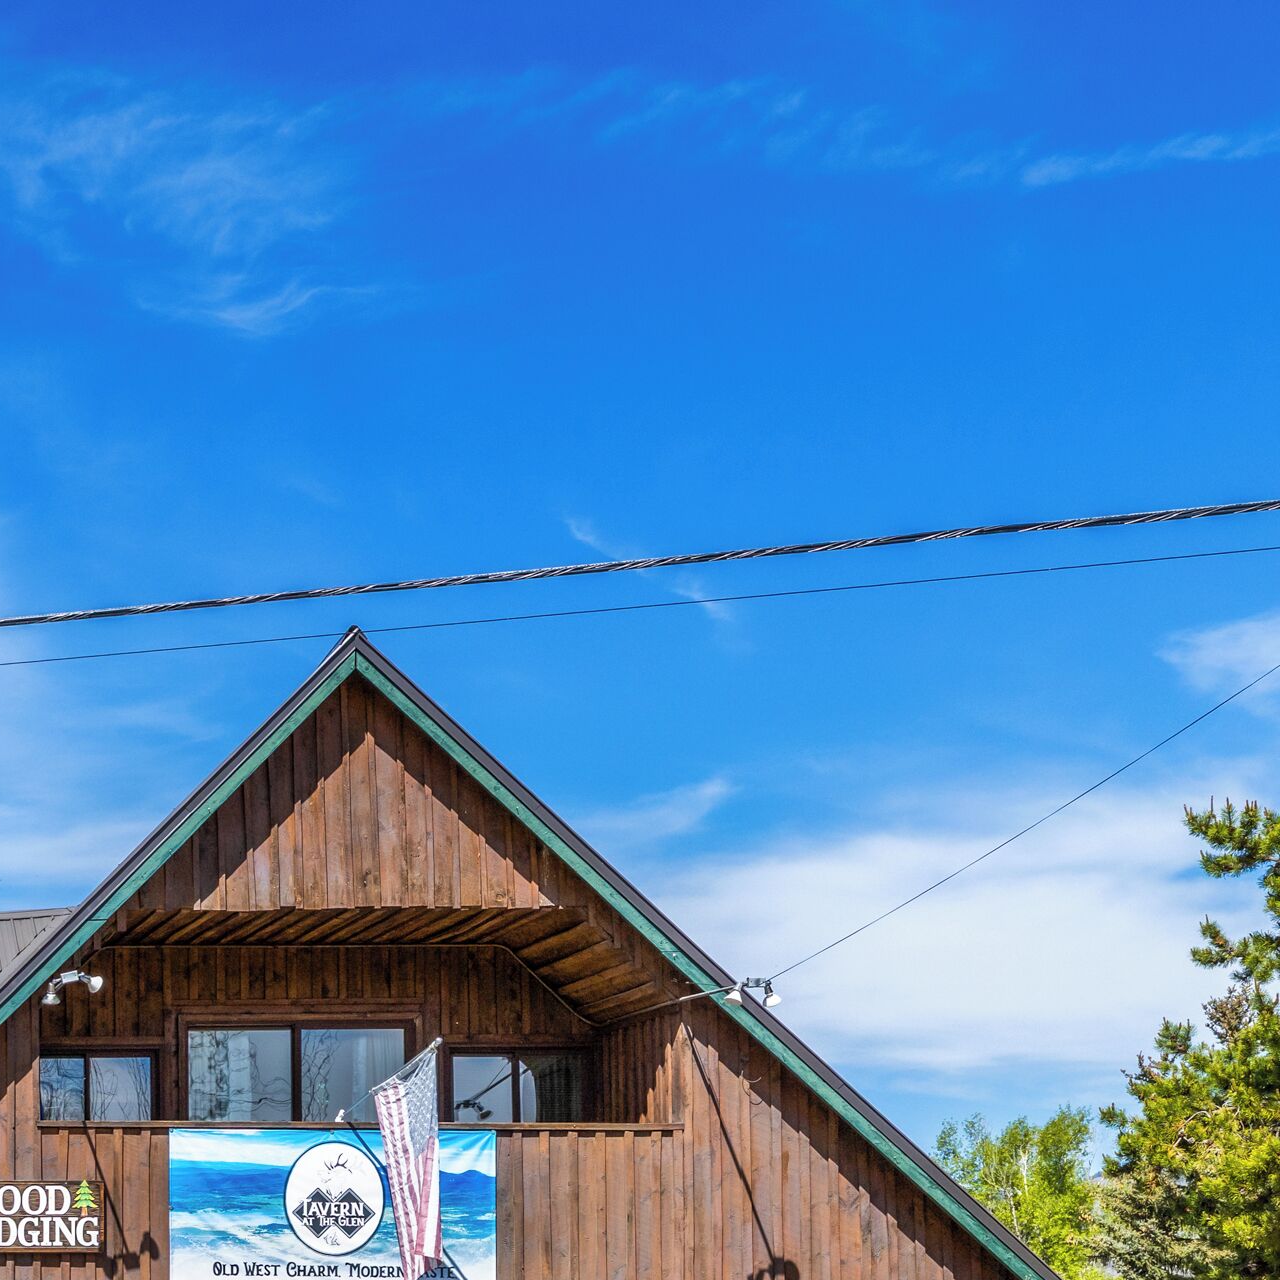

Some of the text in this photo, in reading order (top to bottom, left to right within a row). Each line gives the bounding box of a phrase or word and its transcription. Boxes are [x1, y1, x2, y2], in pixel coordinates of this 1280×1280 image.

[301, 1198, 364, 1216] TAVERN
[302, 1215, 365, 1227] AT THE GLEN
[213, 1261, 239, 1276] OLD
[244, 1261, 280, 1277] WEST
